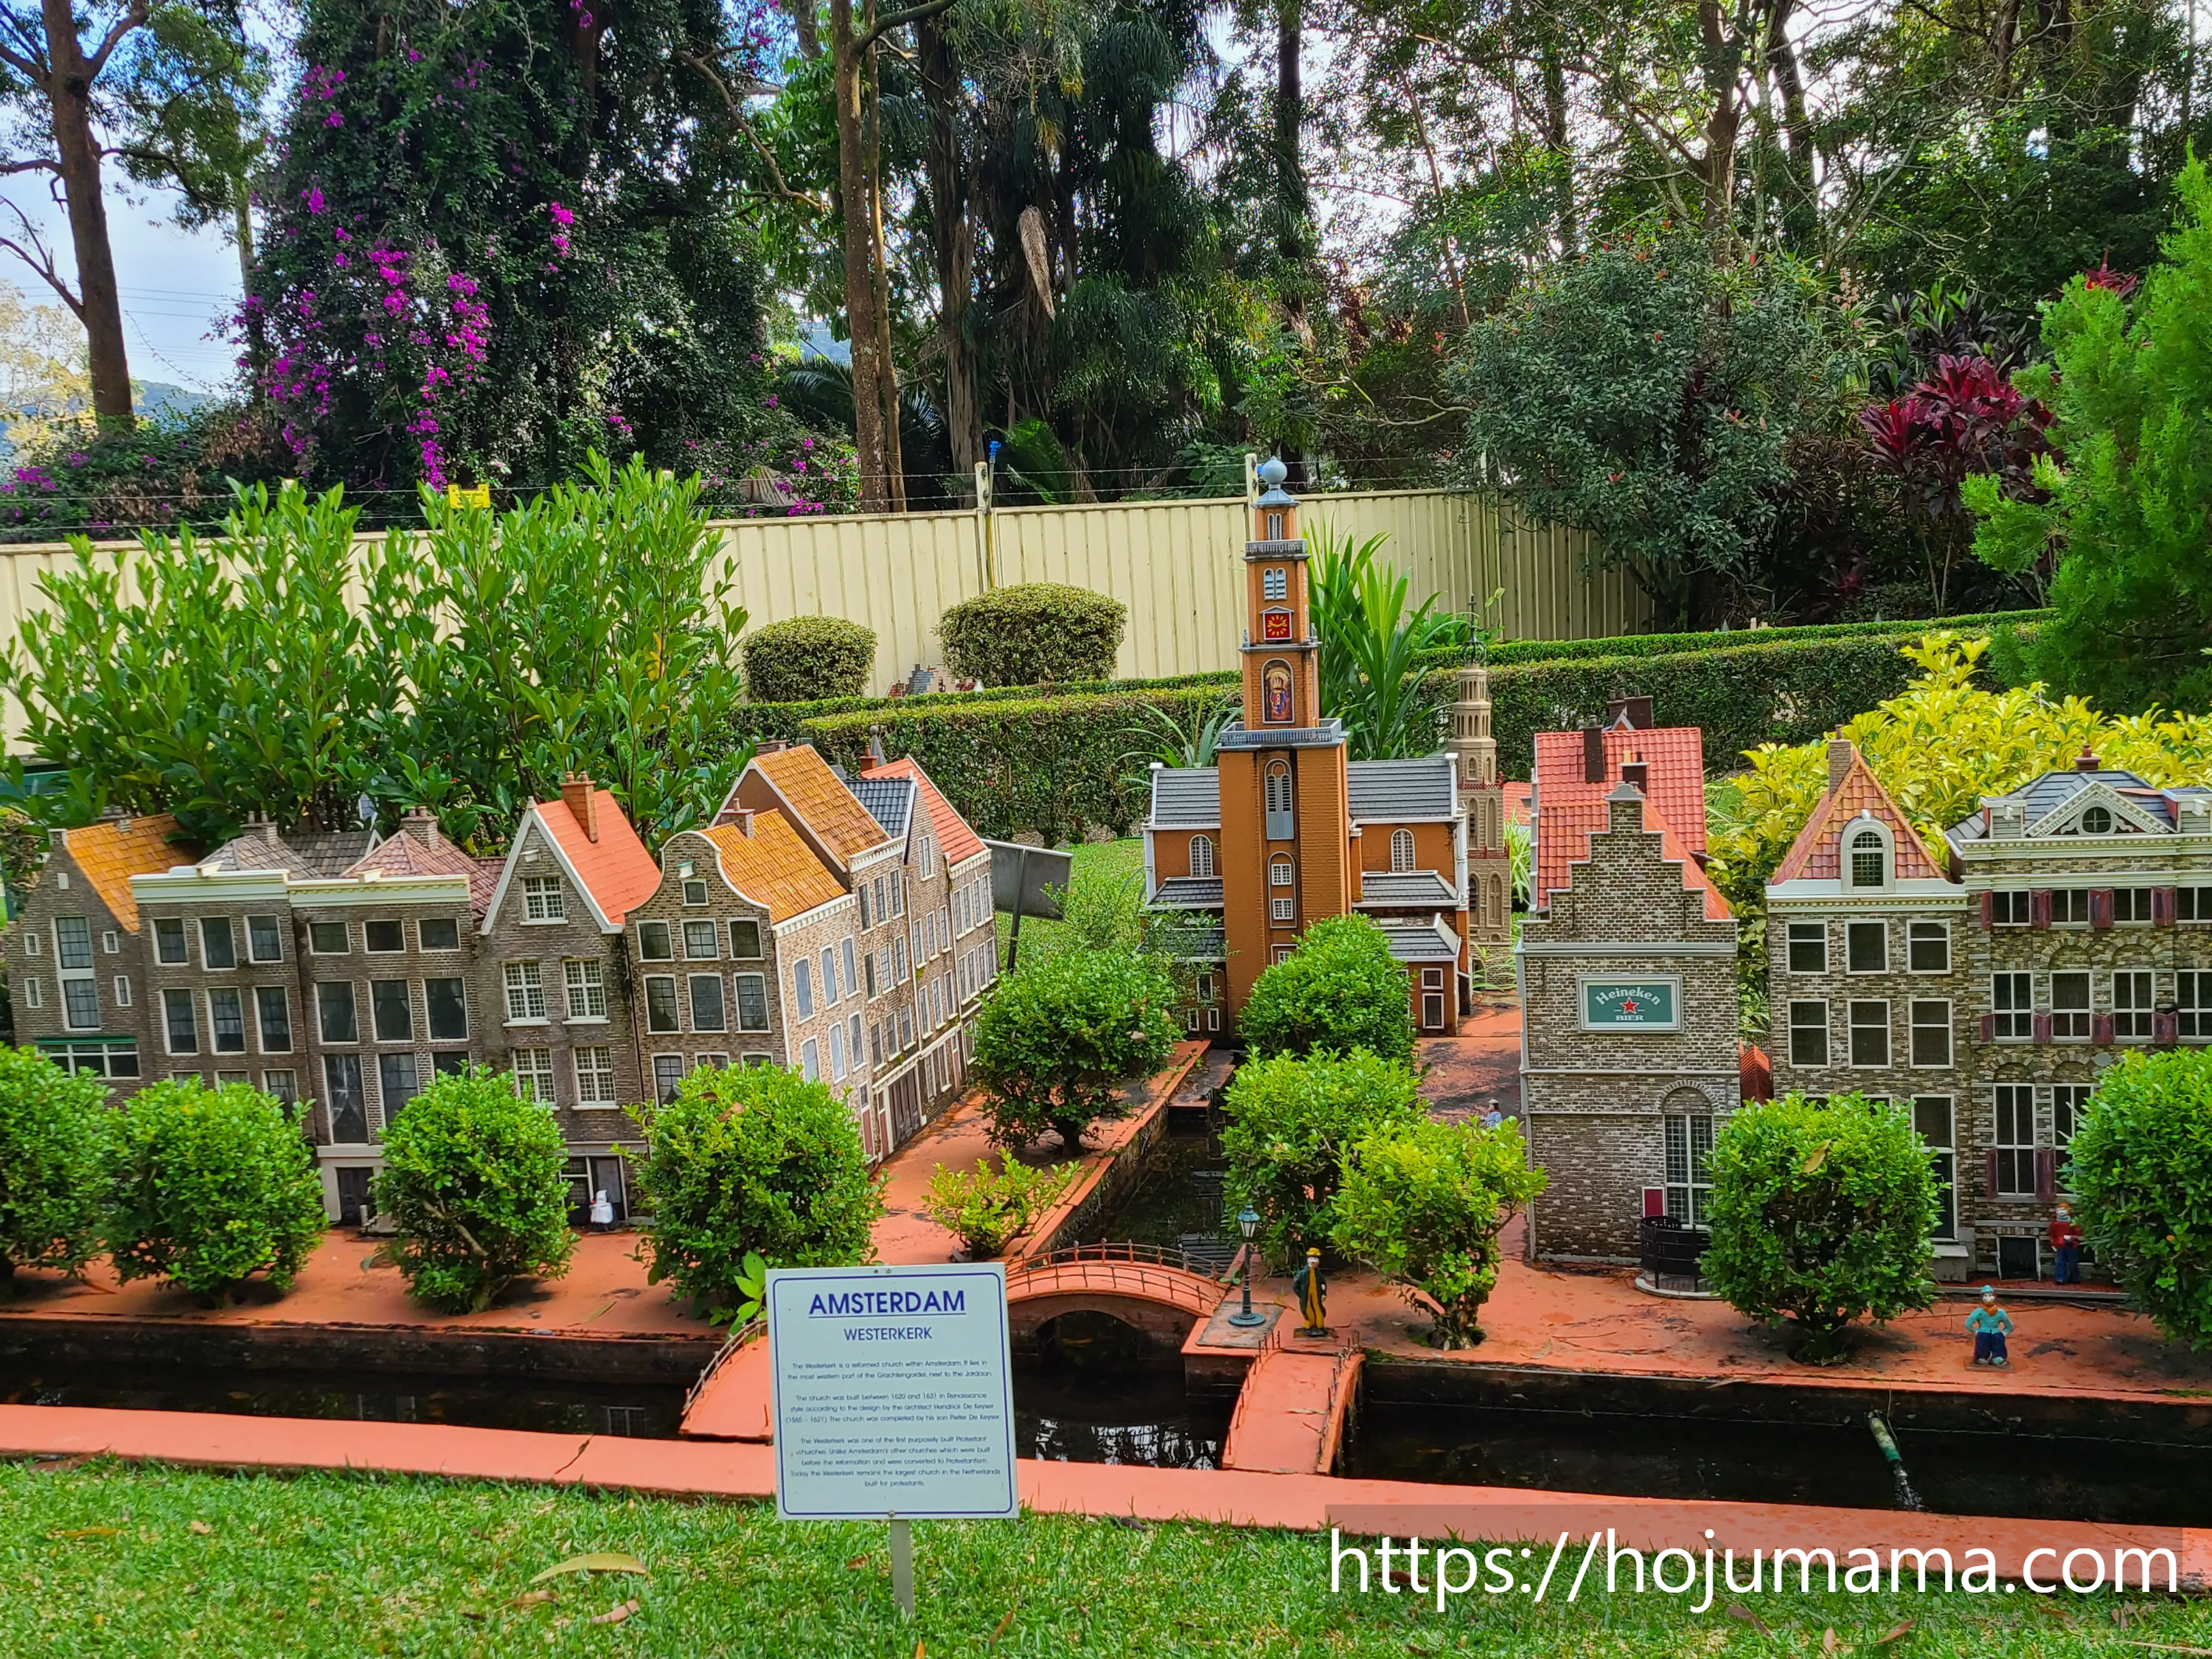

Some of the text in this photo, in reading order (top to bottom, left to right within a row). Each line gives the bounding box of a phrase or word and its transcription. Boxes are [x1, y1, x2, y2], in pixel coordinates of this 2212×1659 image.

[1595, 987, 1660, 1006] Heineken
[809, 1290, 965, 1315] AMSTERDAM
[844, 1326, 933, 1340] WESTERKERK
